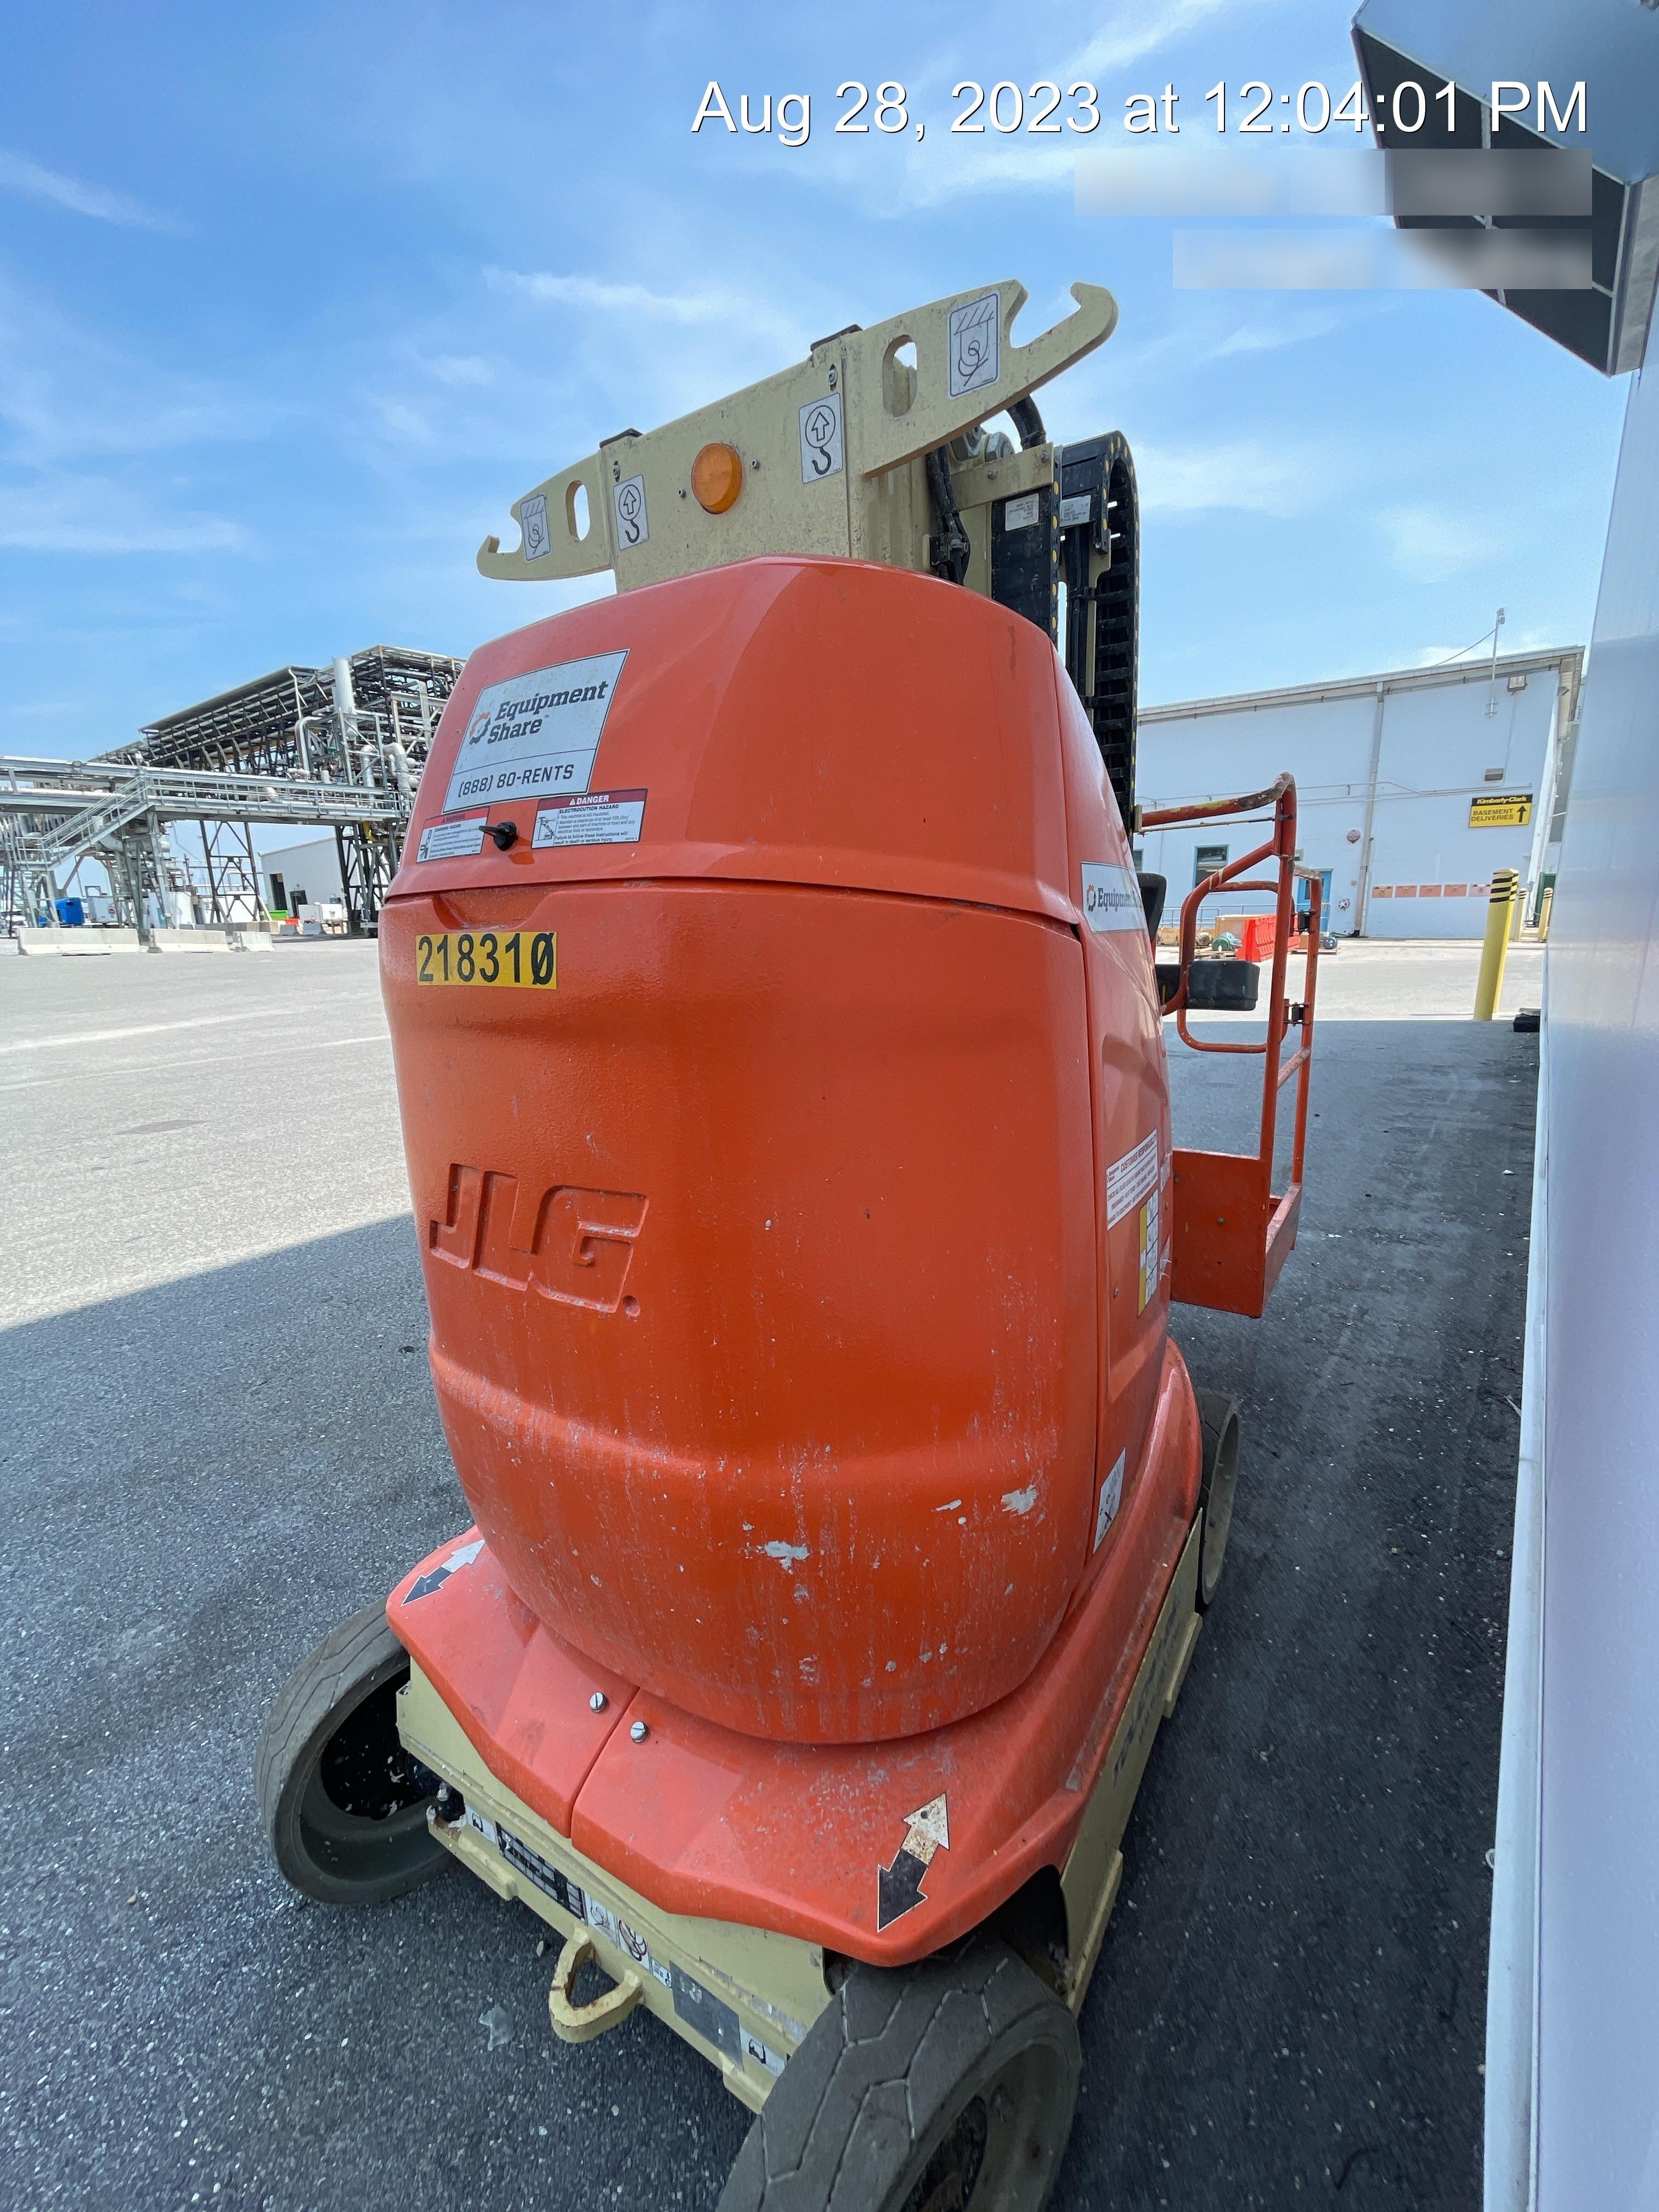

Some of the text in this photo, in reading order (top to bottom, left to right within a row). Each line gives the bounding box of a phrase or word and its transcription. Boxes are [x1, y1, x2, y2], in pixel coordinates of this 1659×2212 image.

[494, 681, 609, 721] Equipment
[487, 719, 543, 744] Share
[458, 764, 574, 798] (888) 80-RENTS
[577, 795, 609, 805] DANGER
[1476, 796, 1527, 804] Kimberly-Clark
[419, 933, 555, 985] 218310
[430, 1162, 650, 1314] JLG
